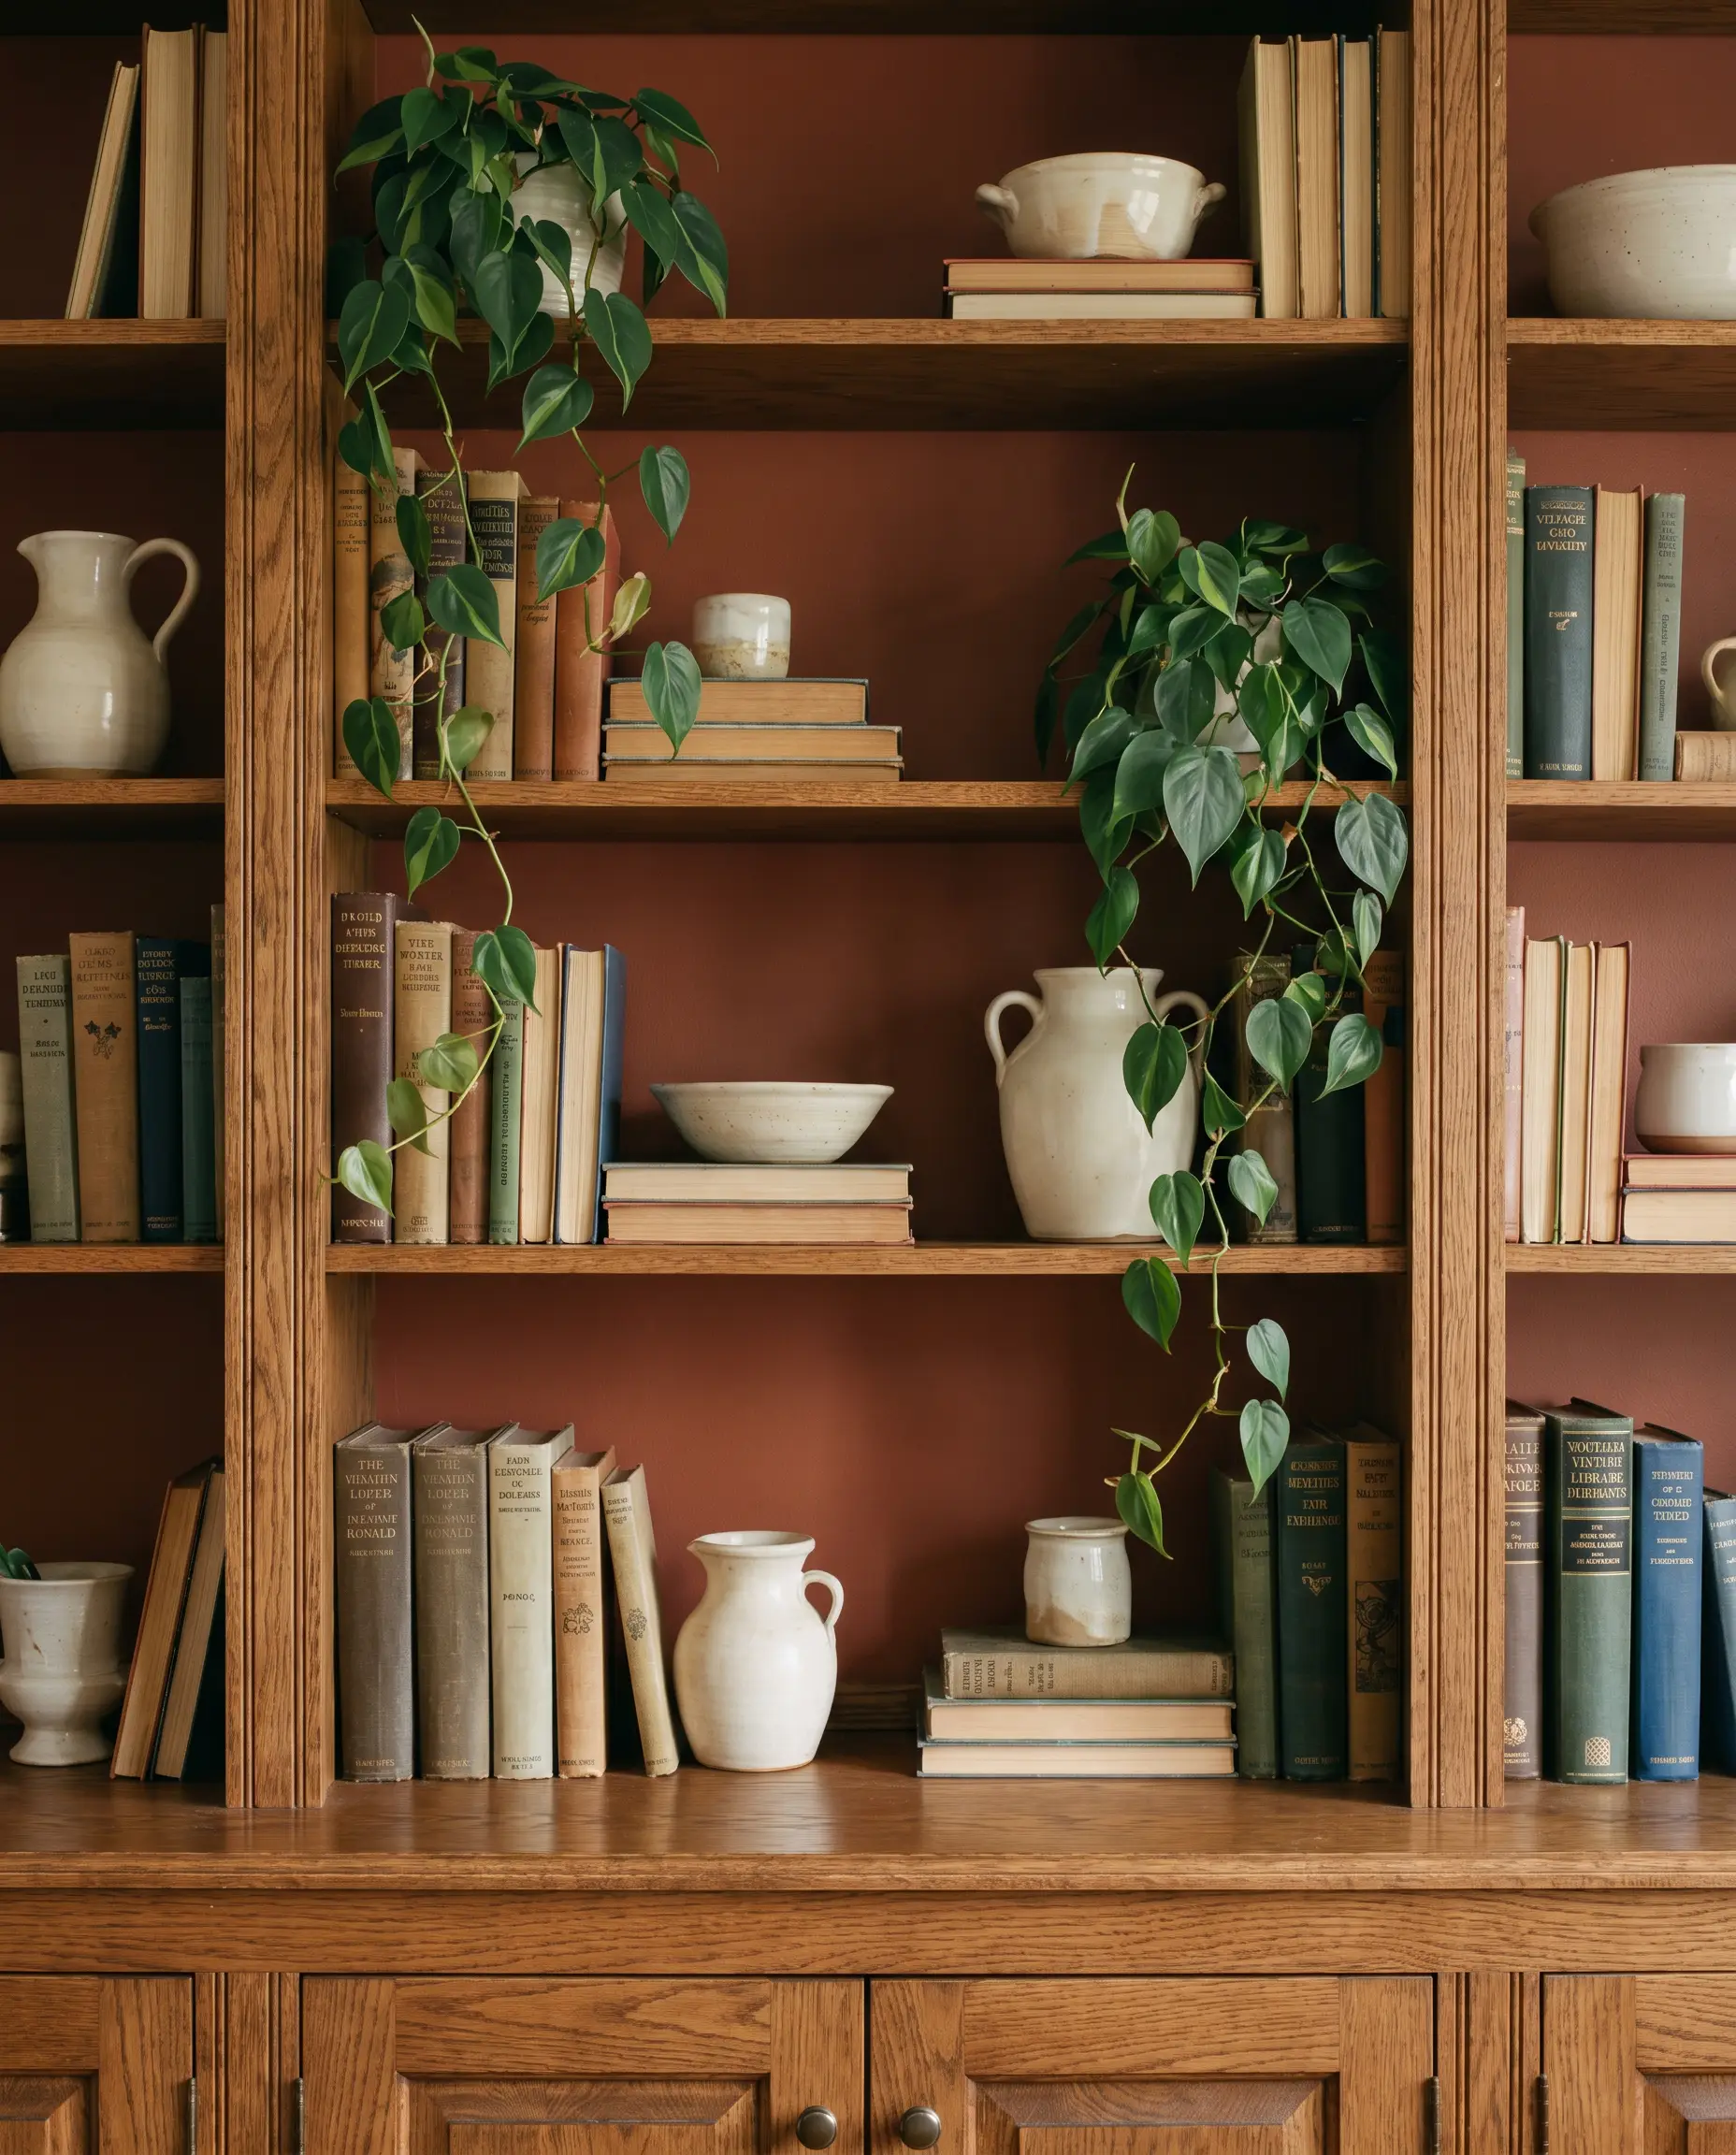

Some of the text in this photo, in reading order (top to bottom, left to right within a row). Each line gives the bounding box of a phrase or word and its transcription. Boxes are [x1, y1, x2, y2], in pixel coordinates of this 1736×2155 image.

[357, 1460, 383, 1470] THE
[436, 1459, 460, 1469] THE
[347, 1527, 397, 1539] RONALD
[425, 1526, 473, 1539] RONALD
